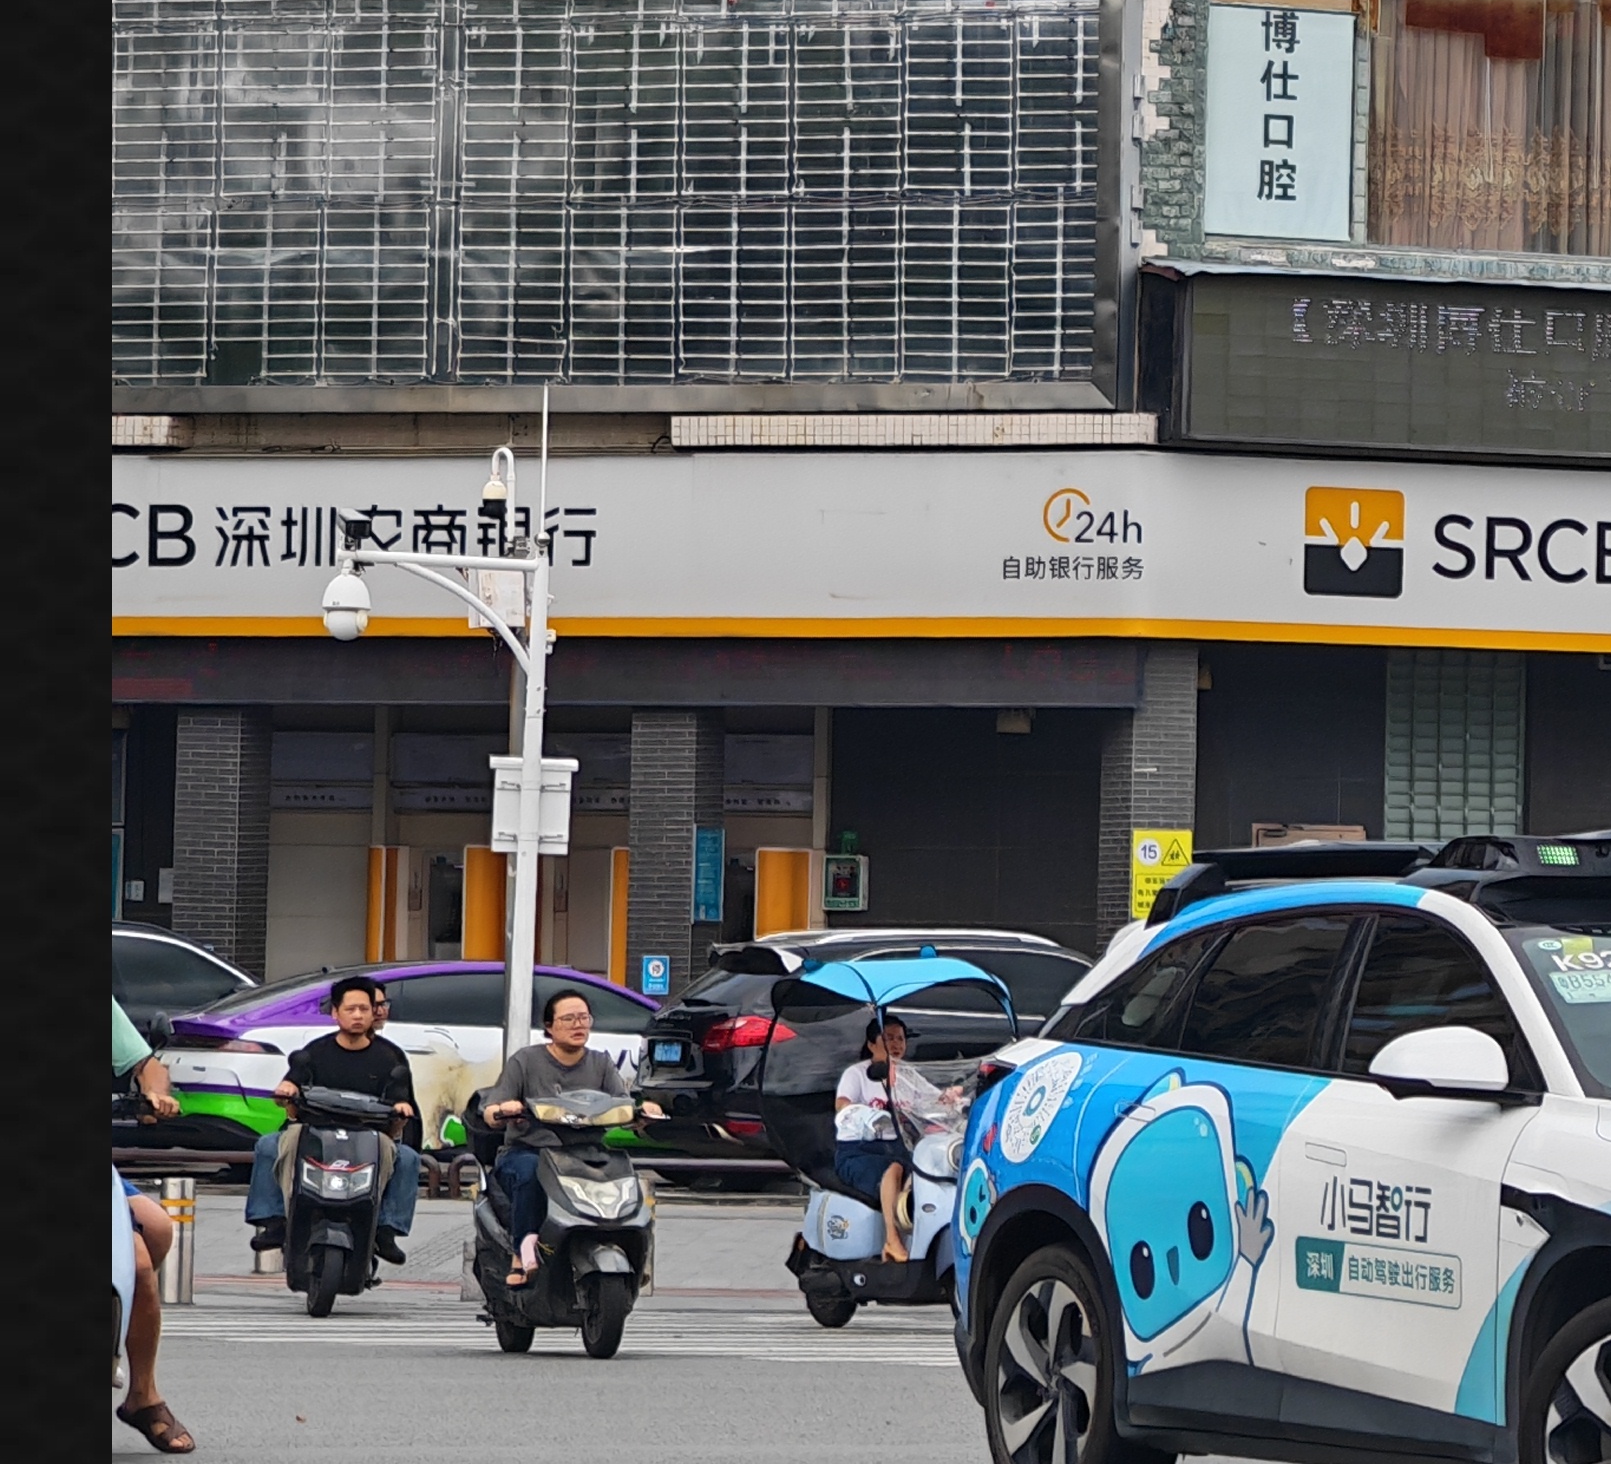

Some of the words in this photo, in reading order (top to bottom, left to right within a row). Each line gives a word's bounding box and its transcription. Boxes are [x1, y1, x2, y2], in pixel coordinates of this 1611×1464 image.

[1257, 10, 1301, 202] 博仕口腔
[1075, 510, 1144, 544] 24h
[1001, 554, 1145, 582] 自助银行服务
[1140, 844, 1158, 860] 15
[1320, 1175, 1432, 1243] 小马智行
[1306, 1251, 1334, 1282] 深圳
[1348, 1255, 1456, 1295] 自动驾驶出行服务
